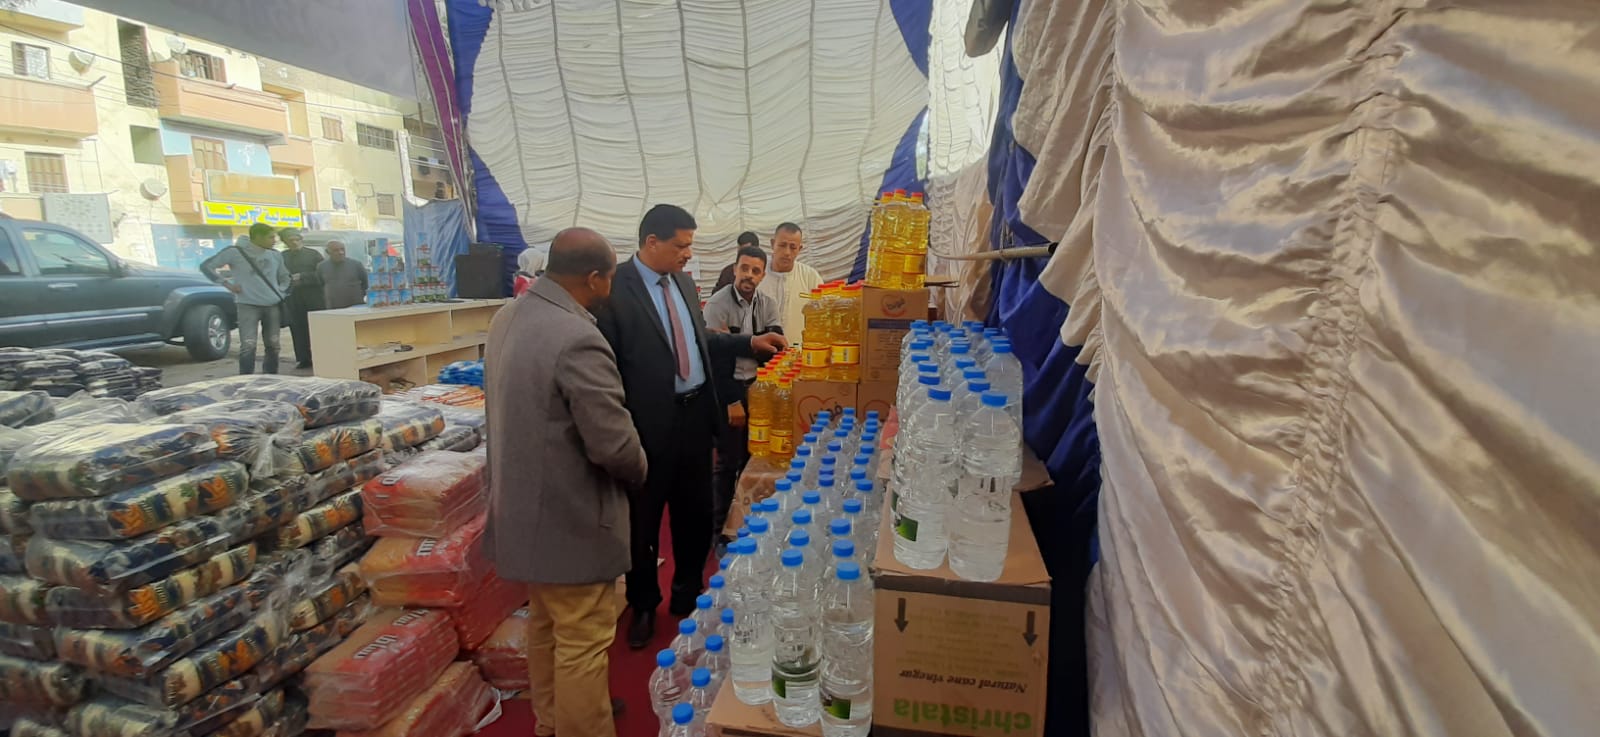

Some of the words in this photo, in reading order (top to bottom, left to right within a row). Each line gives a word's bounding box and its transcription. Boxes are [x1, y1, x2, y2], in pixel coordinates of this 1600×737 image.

[263, 207, 300, 225] صيدلية
[899, 669, 945, 684] vinegar
[946, 675, 978, 686] cane
[978, 679, 1028, 693] Natural
[893, 698, 1032, 734] christala
